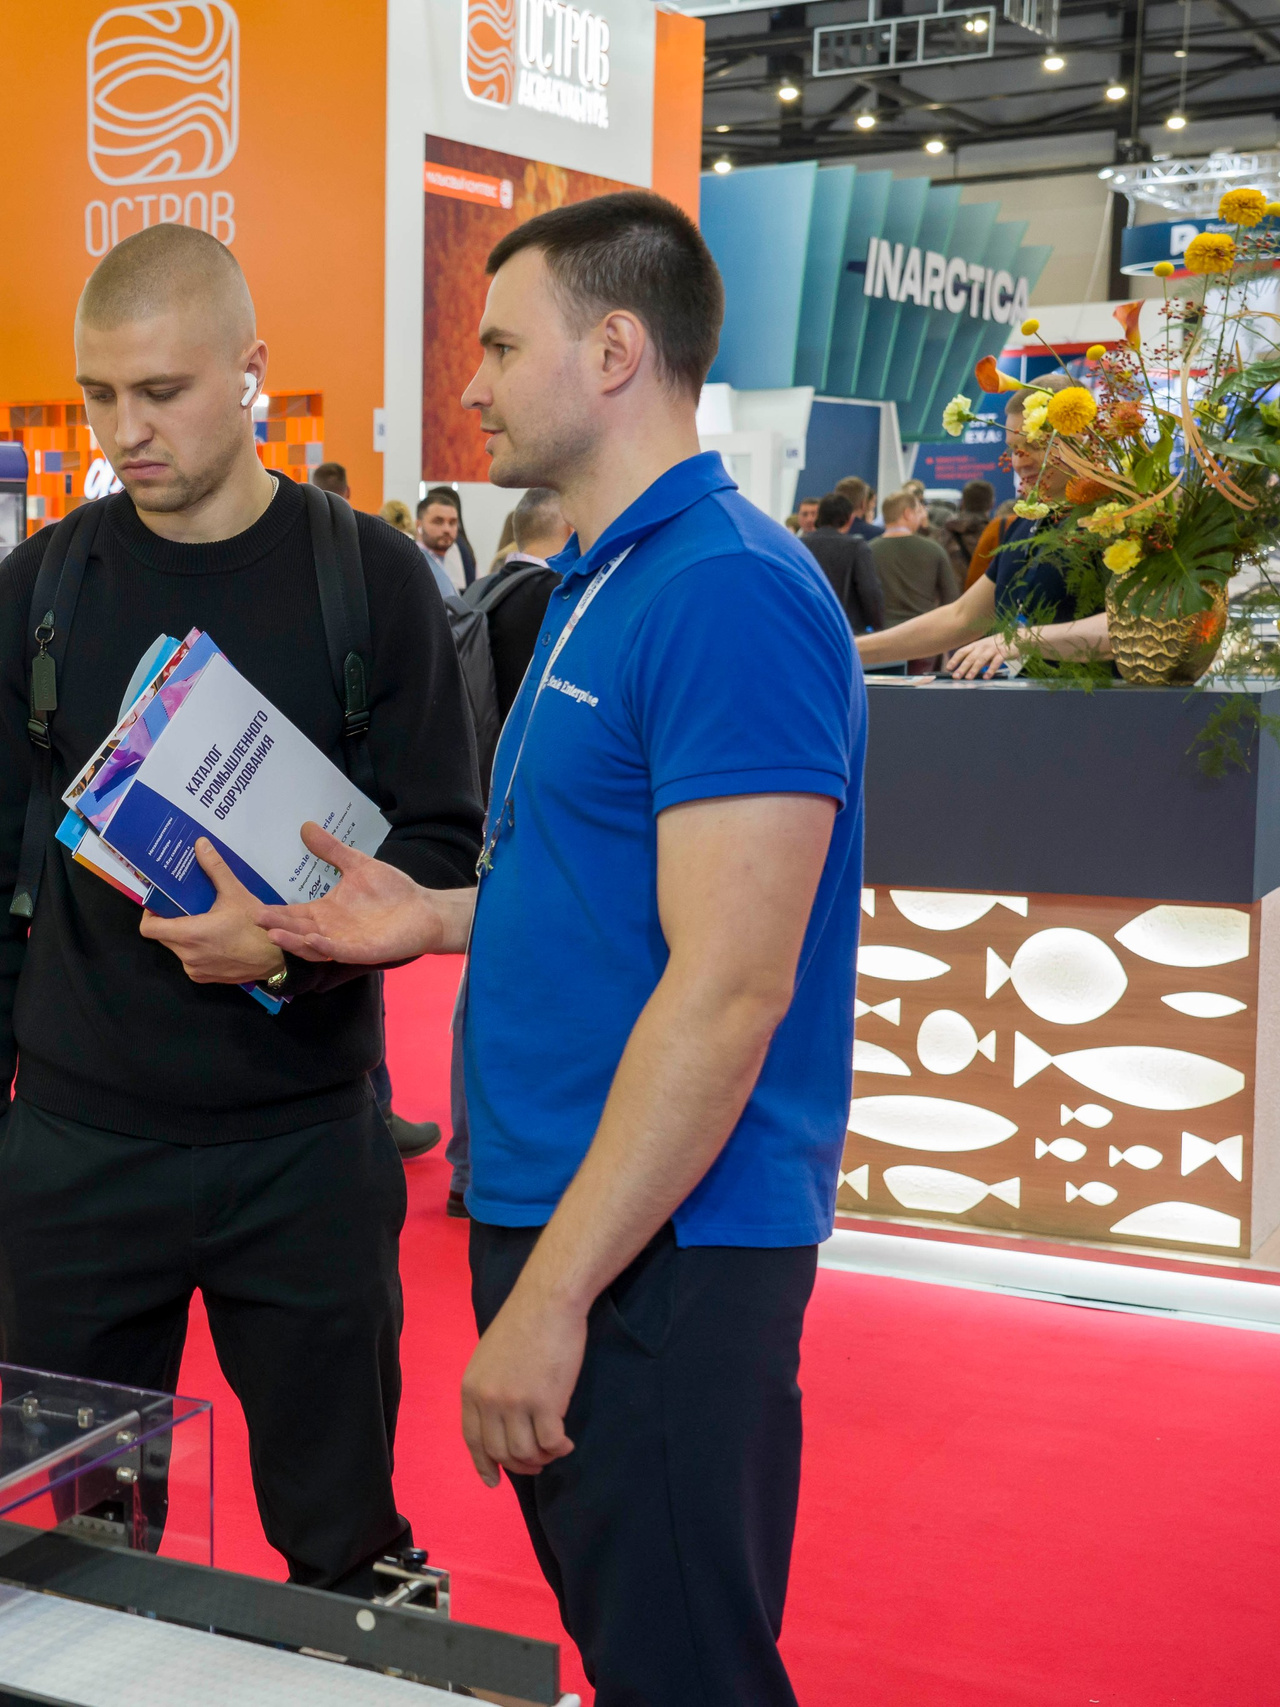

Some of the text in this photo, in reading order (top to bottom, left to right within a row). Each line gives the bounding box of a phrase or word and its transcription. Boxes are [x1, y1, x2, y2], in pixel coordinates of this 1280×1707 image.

[519, 0, 610, 90] ОСТРОВ
[863, 237, 1029, 326] INARCTICA
[185, 744, 222, 796] КАТАЛОГ
[199, 710, 268, 808] ПРОМЫШЛЕННОГО
[214, 734, 275, 820] ОБОРУДОВАНИЯ
[294, 854, 310, 876] Scale
